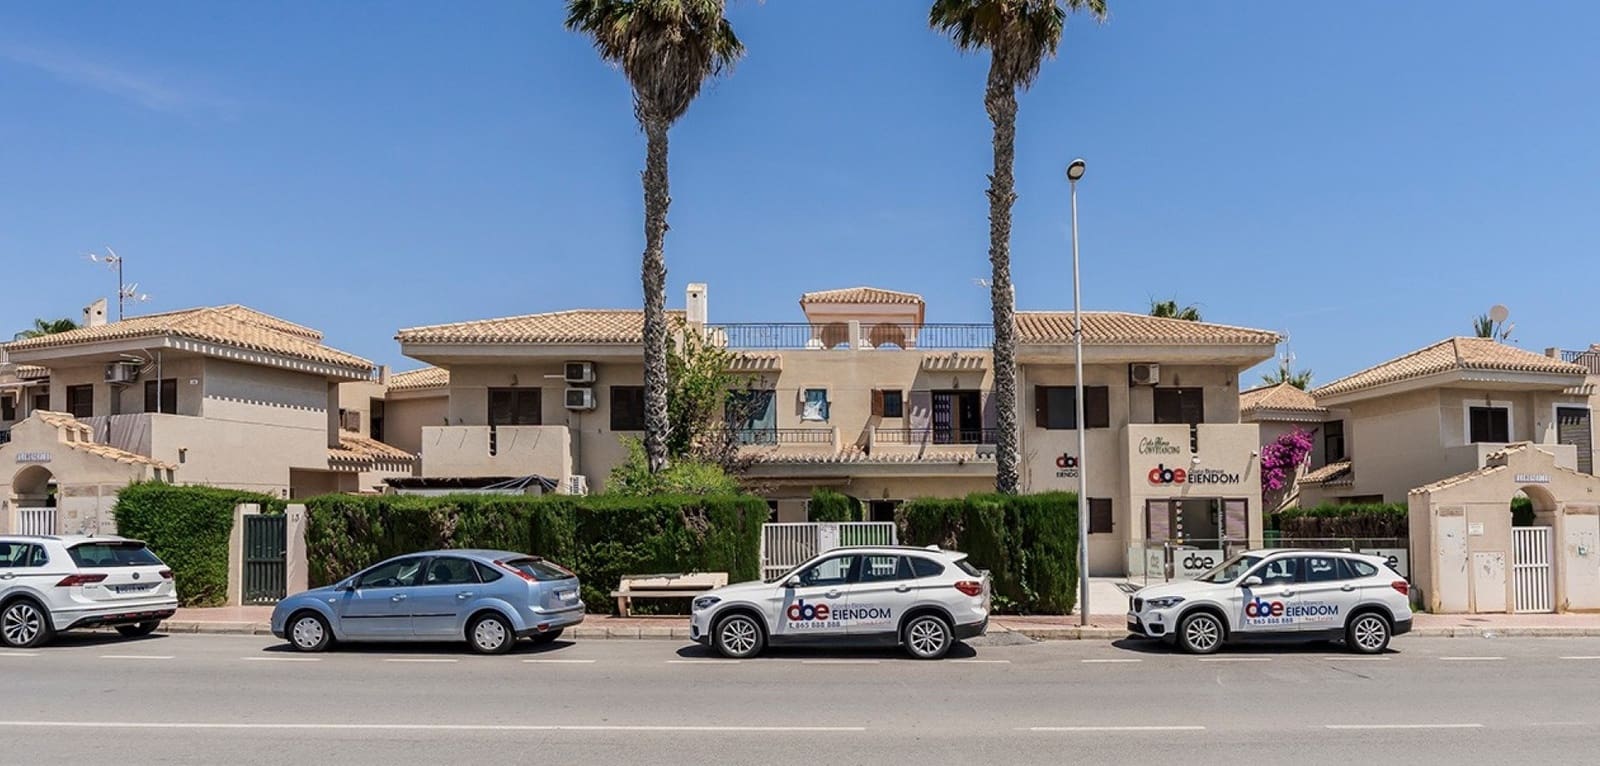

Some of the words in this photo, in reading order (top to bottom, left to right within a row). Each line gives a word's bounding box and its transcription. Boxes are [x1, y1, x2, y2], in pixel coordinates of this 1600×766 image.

[1188, 473, 1240, 484] EIENDOM
[832, 608, 892, 620] EIENDOM
[1286, 605, 1339, 617] EIENDOM
